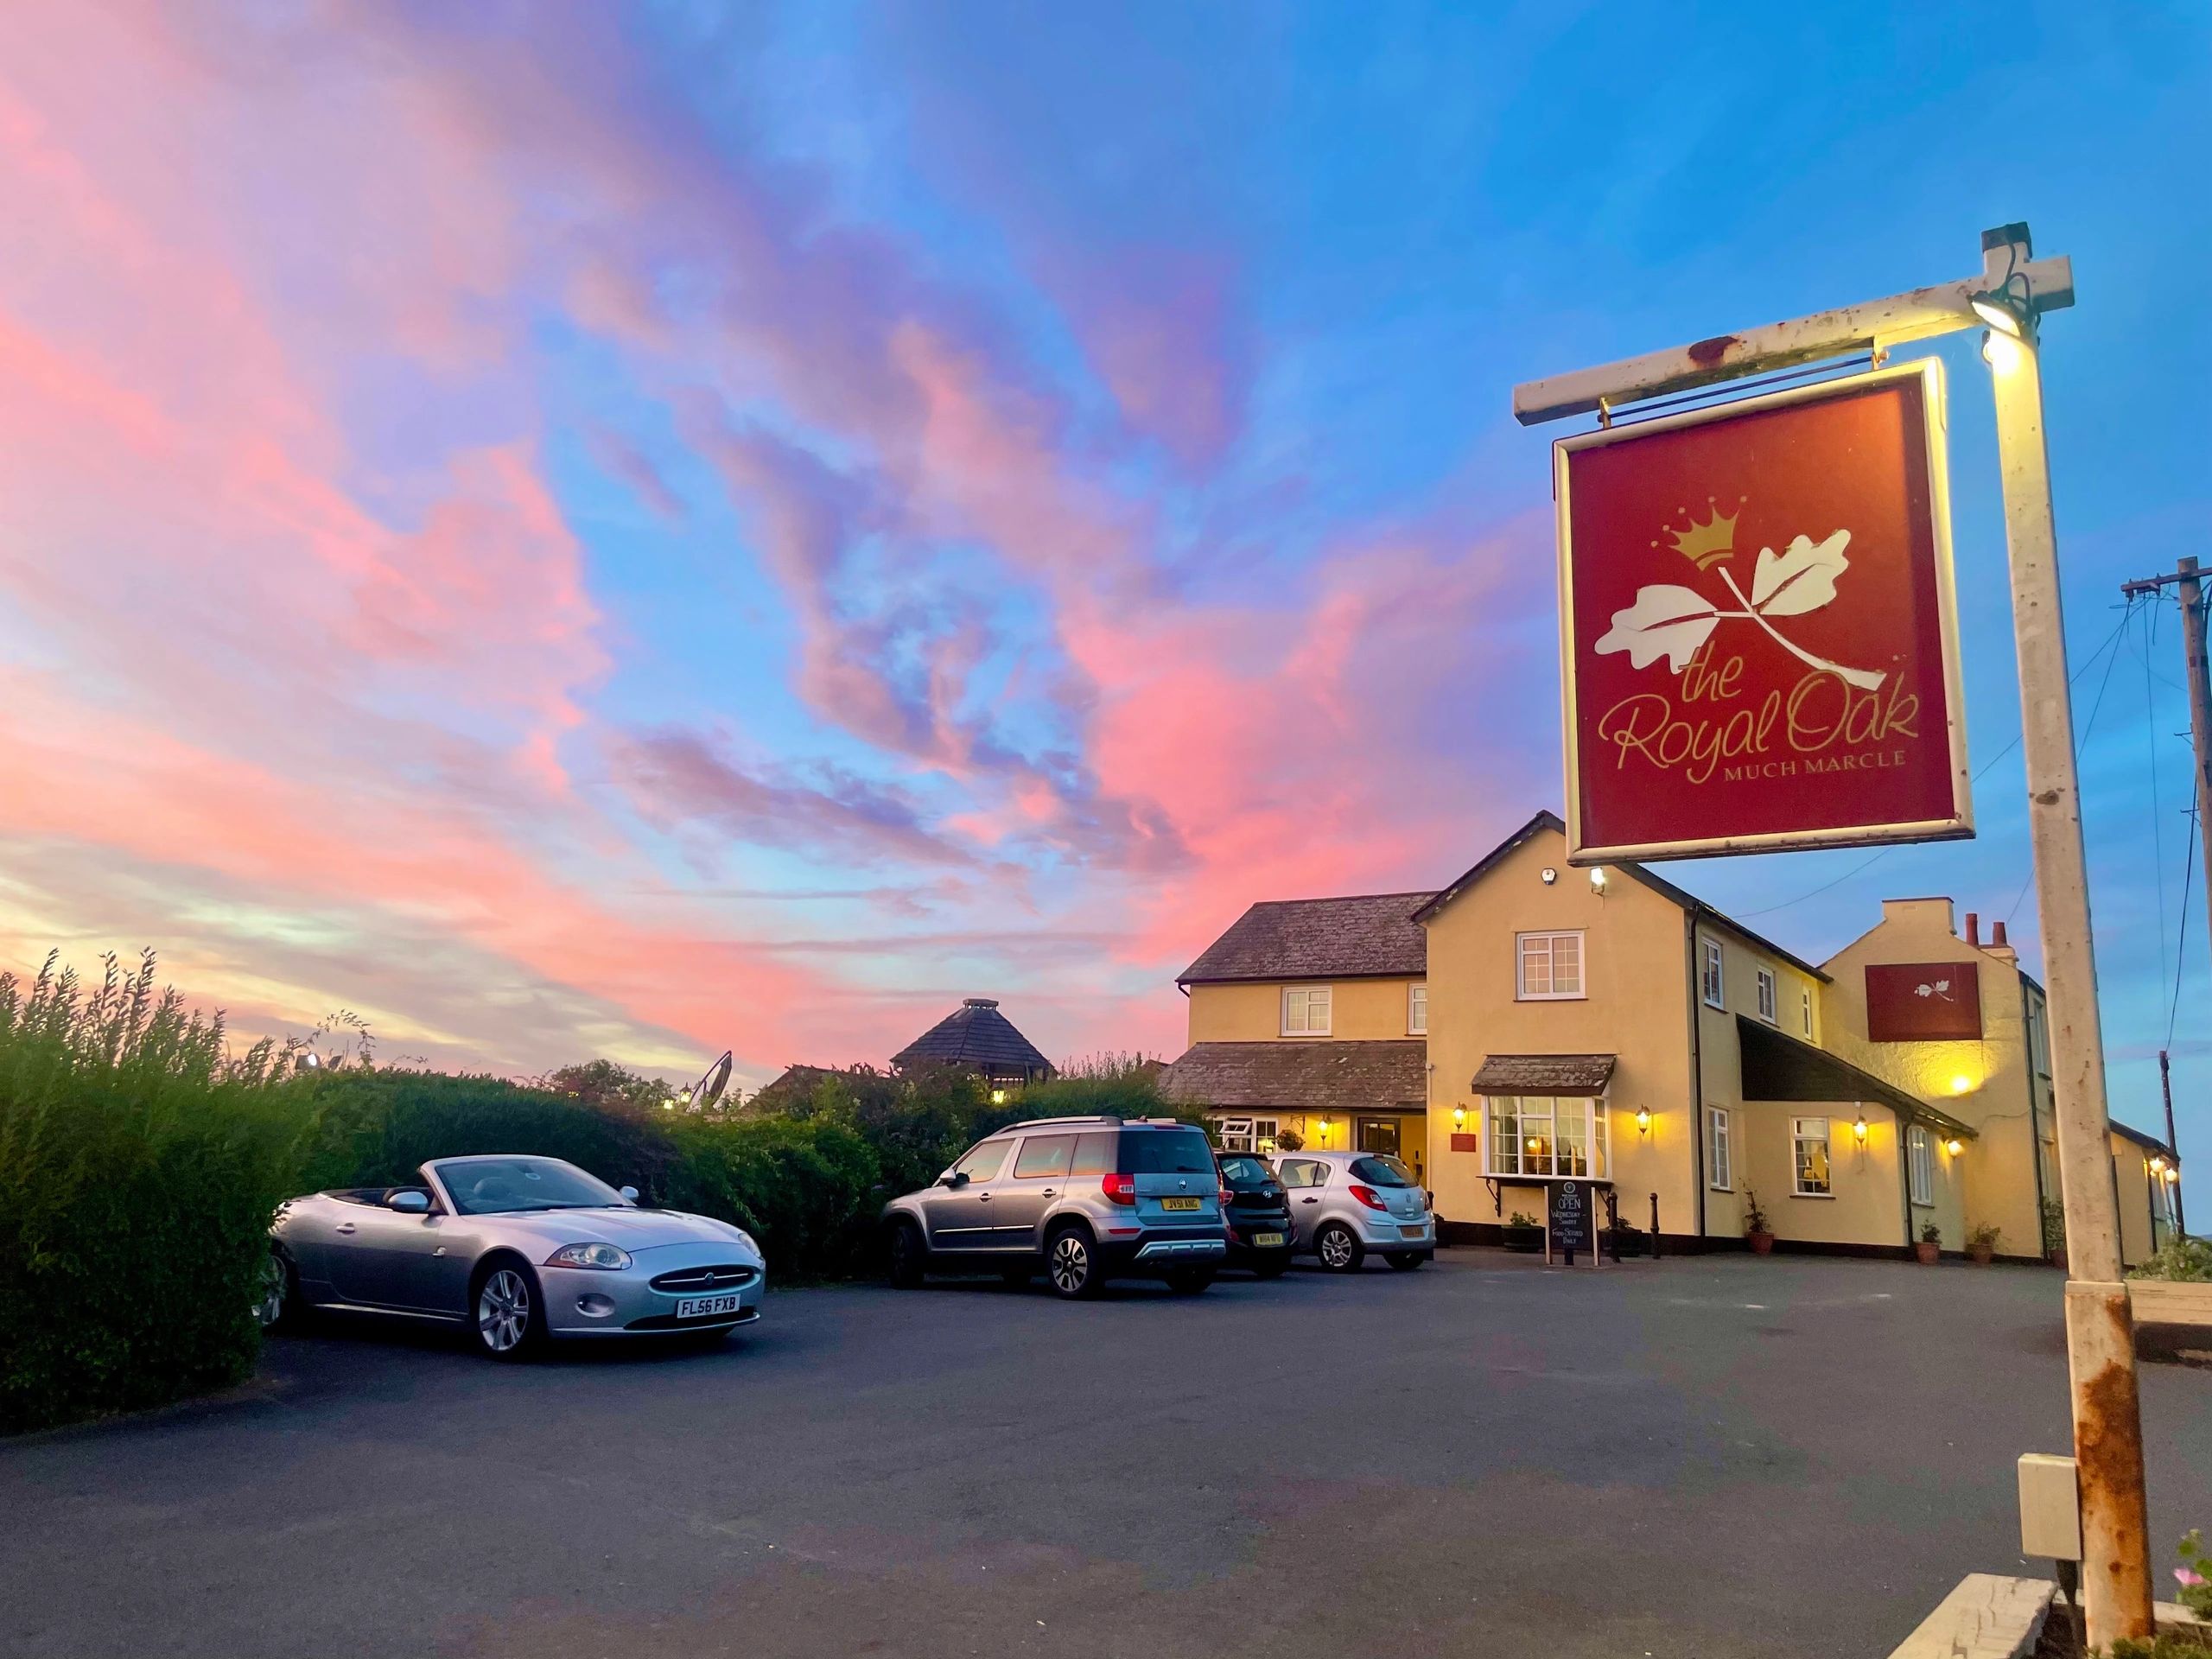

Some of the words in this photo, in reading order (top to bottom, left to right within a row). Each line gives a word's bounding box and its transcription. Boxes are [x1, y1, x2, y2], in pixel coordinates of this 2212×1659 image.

[1678, 640, 1744, 703] the
[1599, 690, 1781, 784] Royal
[1787, 669, 1919, 753] Oak
[1724, 761, 1797, 782] MUCH
[1805, 750, 1906, 774] MARCLE
[1558, 1198, 1581, 1210] OPEN
[682, 1300, 712, 1314] FL56
[715, 1297, 736, 1311] FXB
